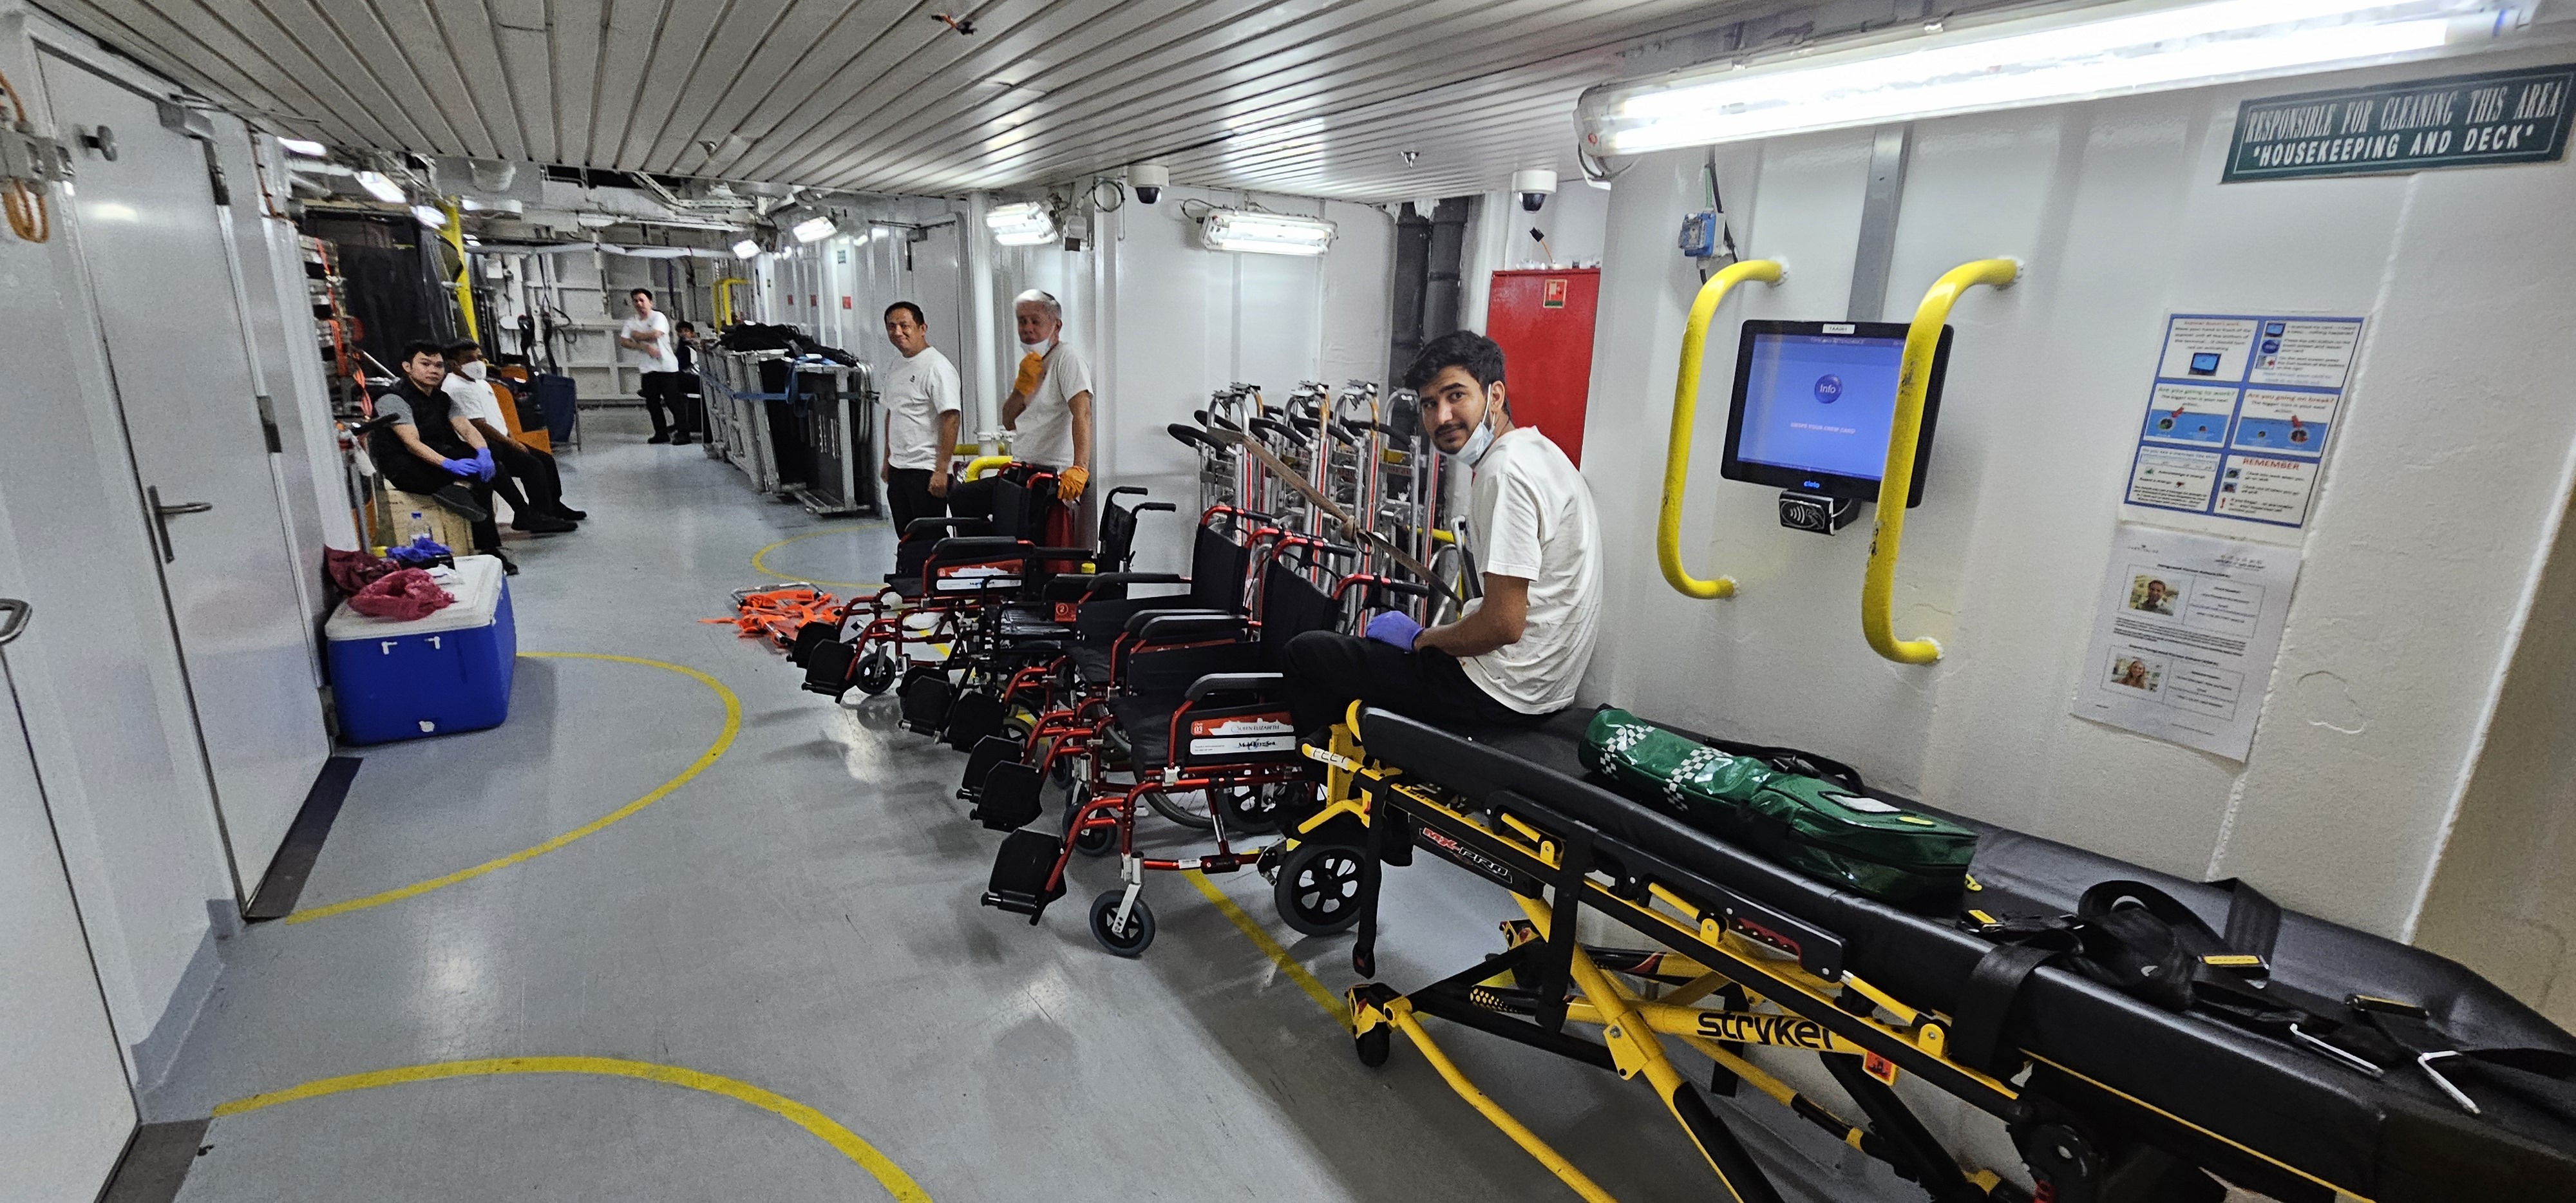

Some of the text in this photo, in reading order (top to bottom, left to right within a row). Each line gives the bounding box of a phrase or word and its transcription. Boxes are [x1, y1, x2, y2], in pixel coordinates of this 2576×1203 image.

[2246, 81, 2564, 142] RESPONSIBLE FOR CLEANING THIS AREA
[2409, 129, 2452, 156] AND
[1819, 384, 1836, 394] Info
[2242, 458, 2300, 470] REMEMBER
[1313, 748, 1347, 763] FEET
[1423, 827, 1508, 876] MX-PRO
[1696, 1011, 1833, 1050] stryker
